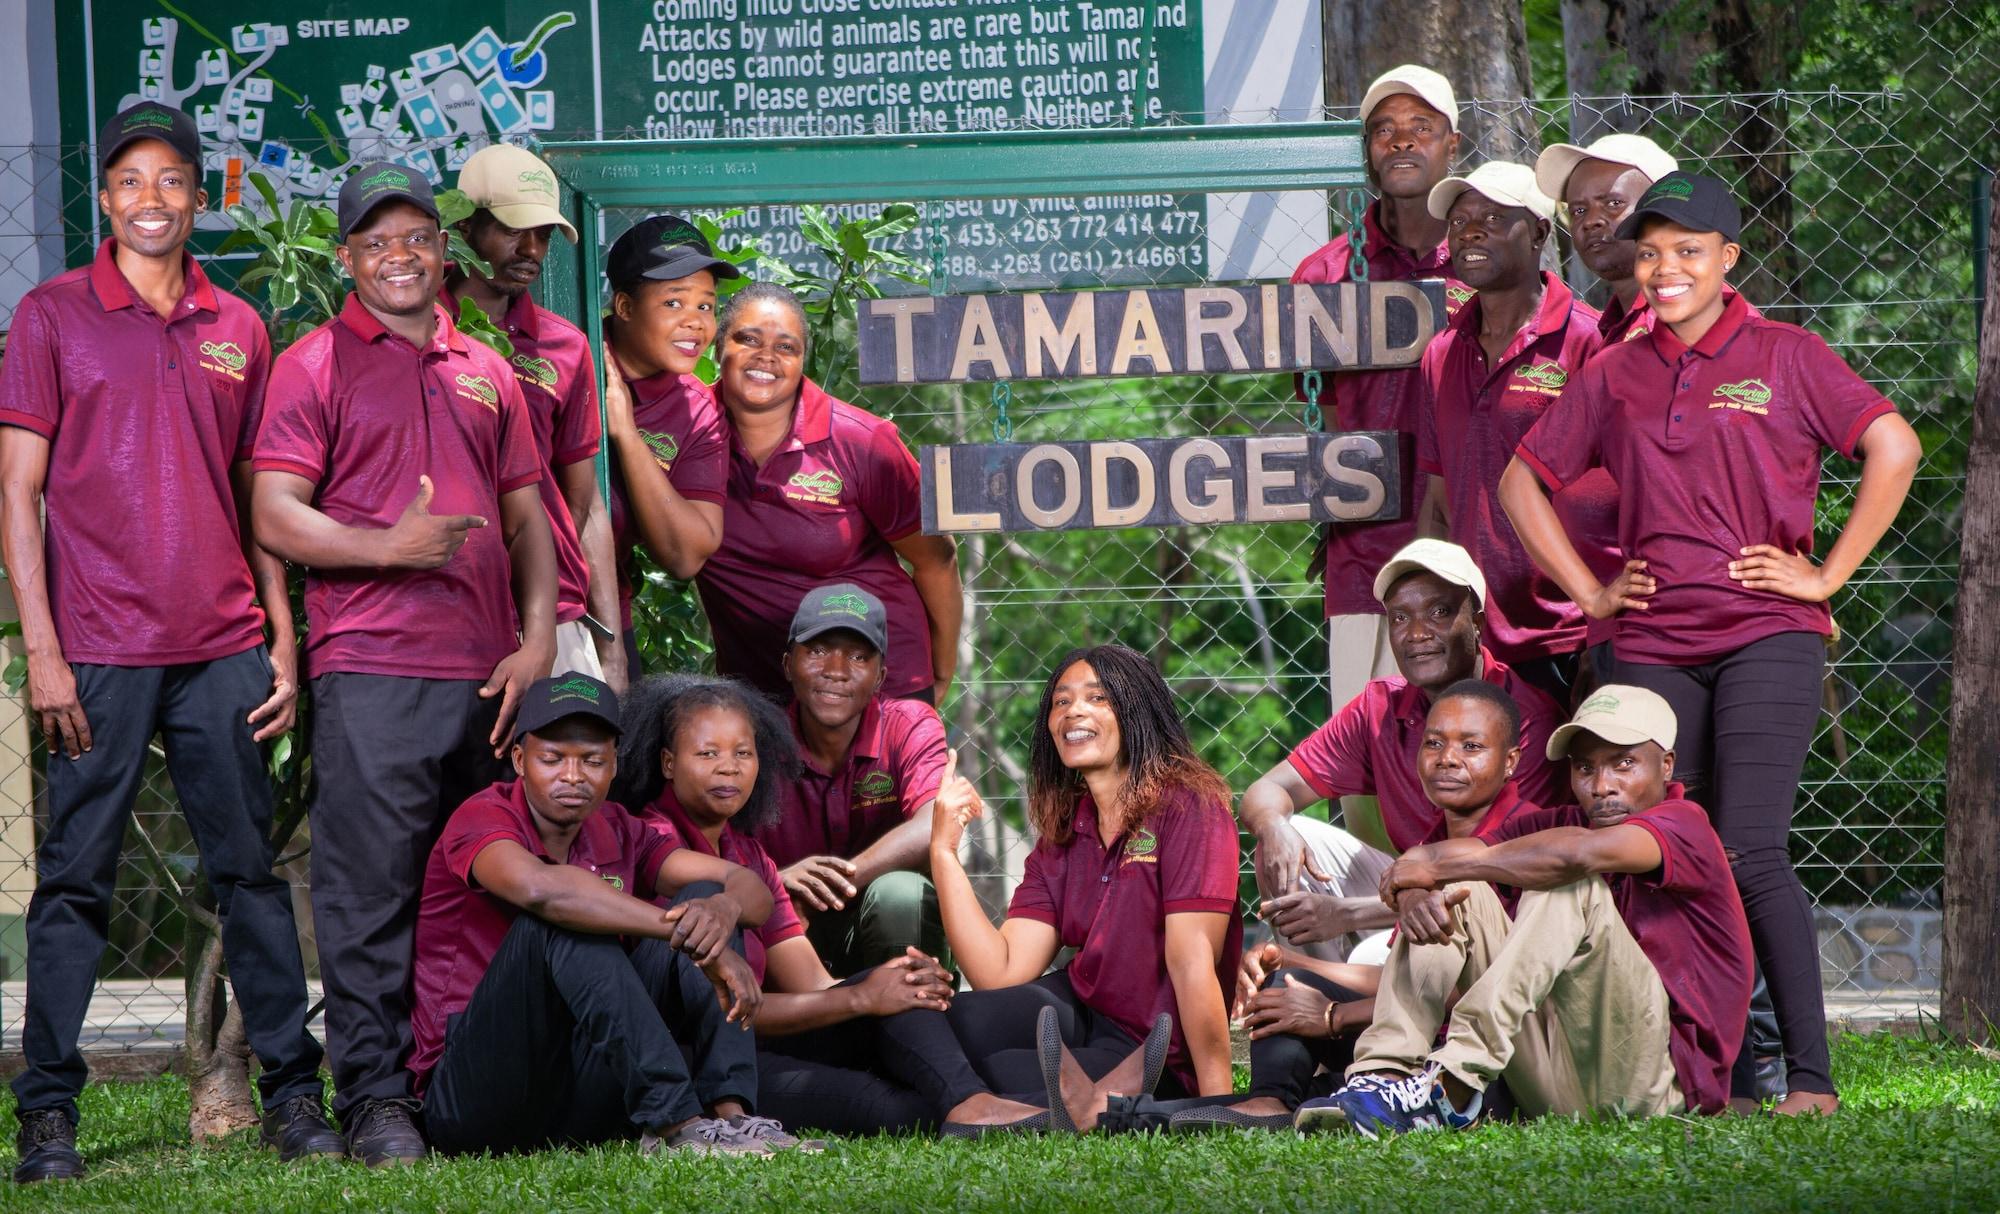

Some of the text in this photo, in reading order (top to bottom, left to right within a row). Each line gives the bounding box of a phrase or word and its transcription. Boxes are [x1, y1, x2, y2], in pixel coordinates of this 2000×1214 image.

[297, 18, 410, 38] SITE MAP
[639, 0, 1186, 52] Attacks by wild animals are rare but Tamand
[653, 0, 737, 22] coming
[746, 0, 792, 16] into
[868, 0, 954, 10] cont
[652, 54, 736, 84] Lodges
[744, 49, 824, 79] cannot
[833, 45, 951, 79] guarantee
[960, 41, 1007, 69] that
[1014, 37, 1059, 68] this
[1067, 33, 1107, 64] will
[654, 89, 724, 113] occur.
[734, 82, 808, 111] Please
[816, 77, 911, 108] exercise
[920, 75, 1012, 103] extreme
[1021, 67, 1108, 98] caution
[644, 95, 1162, 139] follow instructions all the time. Neither te
[992, 199, 1018, 218] by
[1083, 194, 1174, 211] animals
[1011, 217, 1061, 243] +263
[1069, 214, 1106, 239] 772
[1115, 213, 1152, 236] 414
[1161, 211, 1200, 234] 477
[991, 253, 1041, 274] +263
[1050, 250, 1104, 275] (261)
[1111, 245, 1202, 270] 2146613
[870, 281, 1435, 382] TAMARIND
[933, 435, 1387, 531] LODGES
